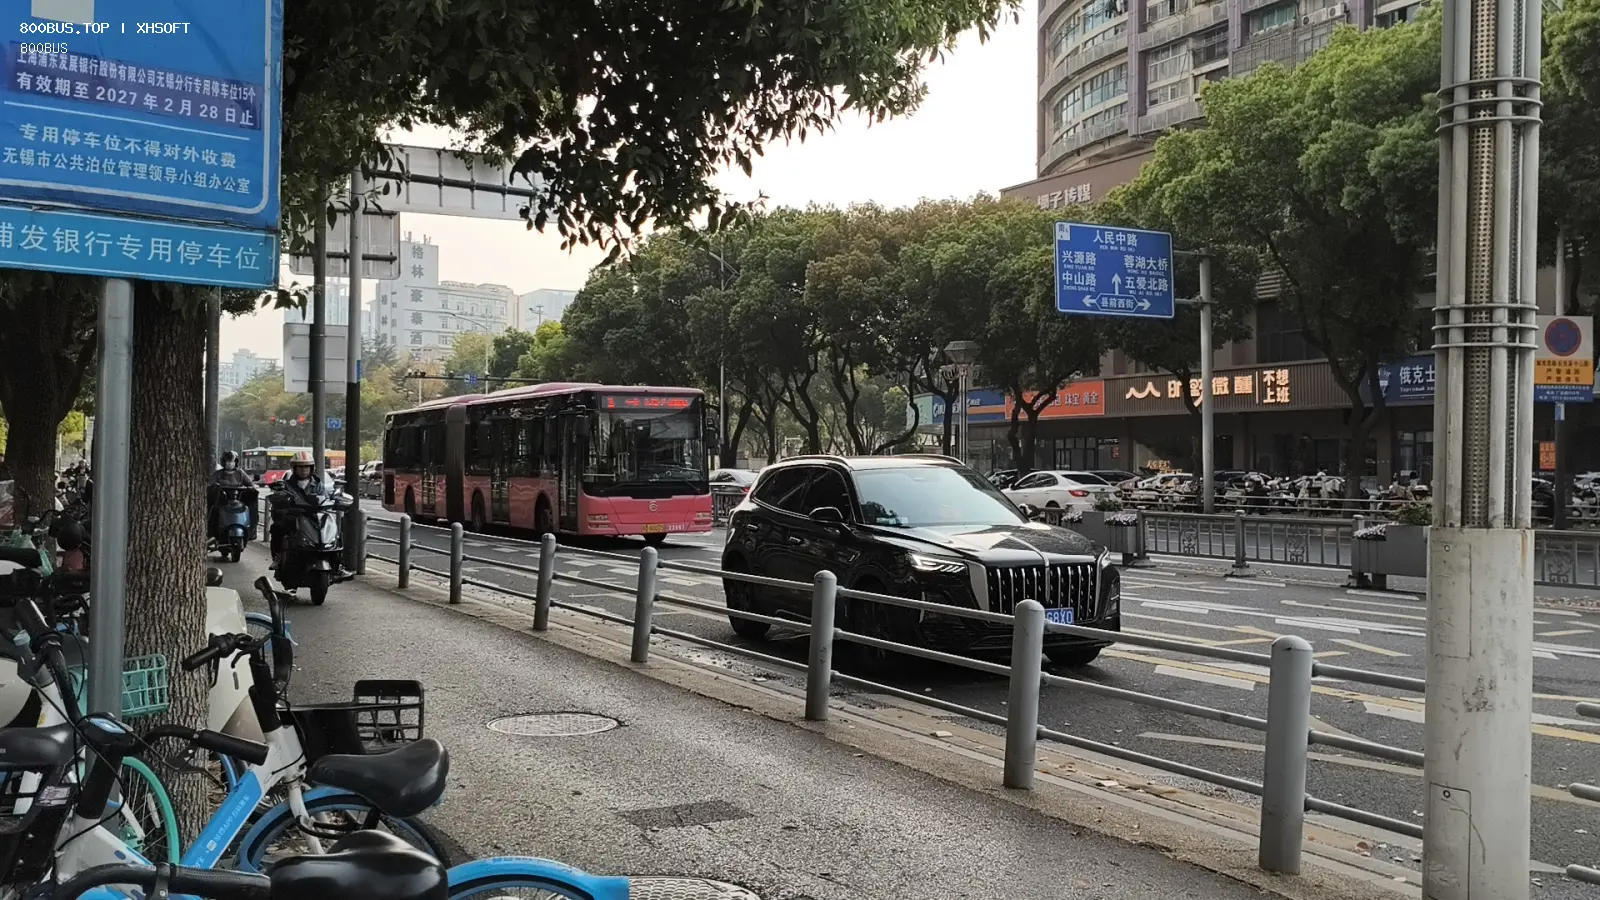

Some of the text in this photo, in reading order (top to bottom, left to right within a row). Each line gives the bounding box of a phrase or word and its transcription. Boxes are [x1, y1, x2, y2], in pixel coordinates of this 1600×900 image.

[19, 123, 236, 169] 专用停车位不得对外收费
[2, 146, 250, 194] 无锡市公共泊位管理领导小组办公室
[1093, 229, 1138, 247] 人民中路
[1062, 250, 1097, 266] 兴源路
[1124, 254, 1168, 272] 蓉湖大桥
[1062, 270, 1097, 287] 中山路
[1125, 276, 1169, 292] 五爱北路
[410, 245, 424, 361] 格林豪泰酒
[1101, 297, 1134, 309] 县前西街
[1263, 369, 1289, 386] 不想
[1263, 387, 1290, 404] 上班
